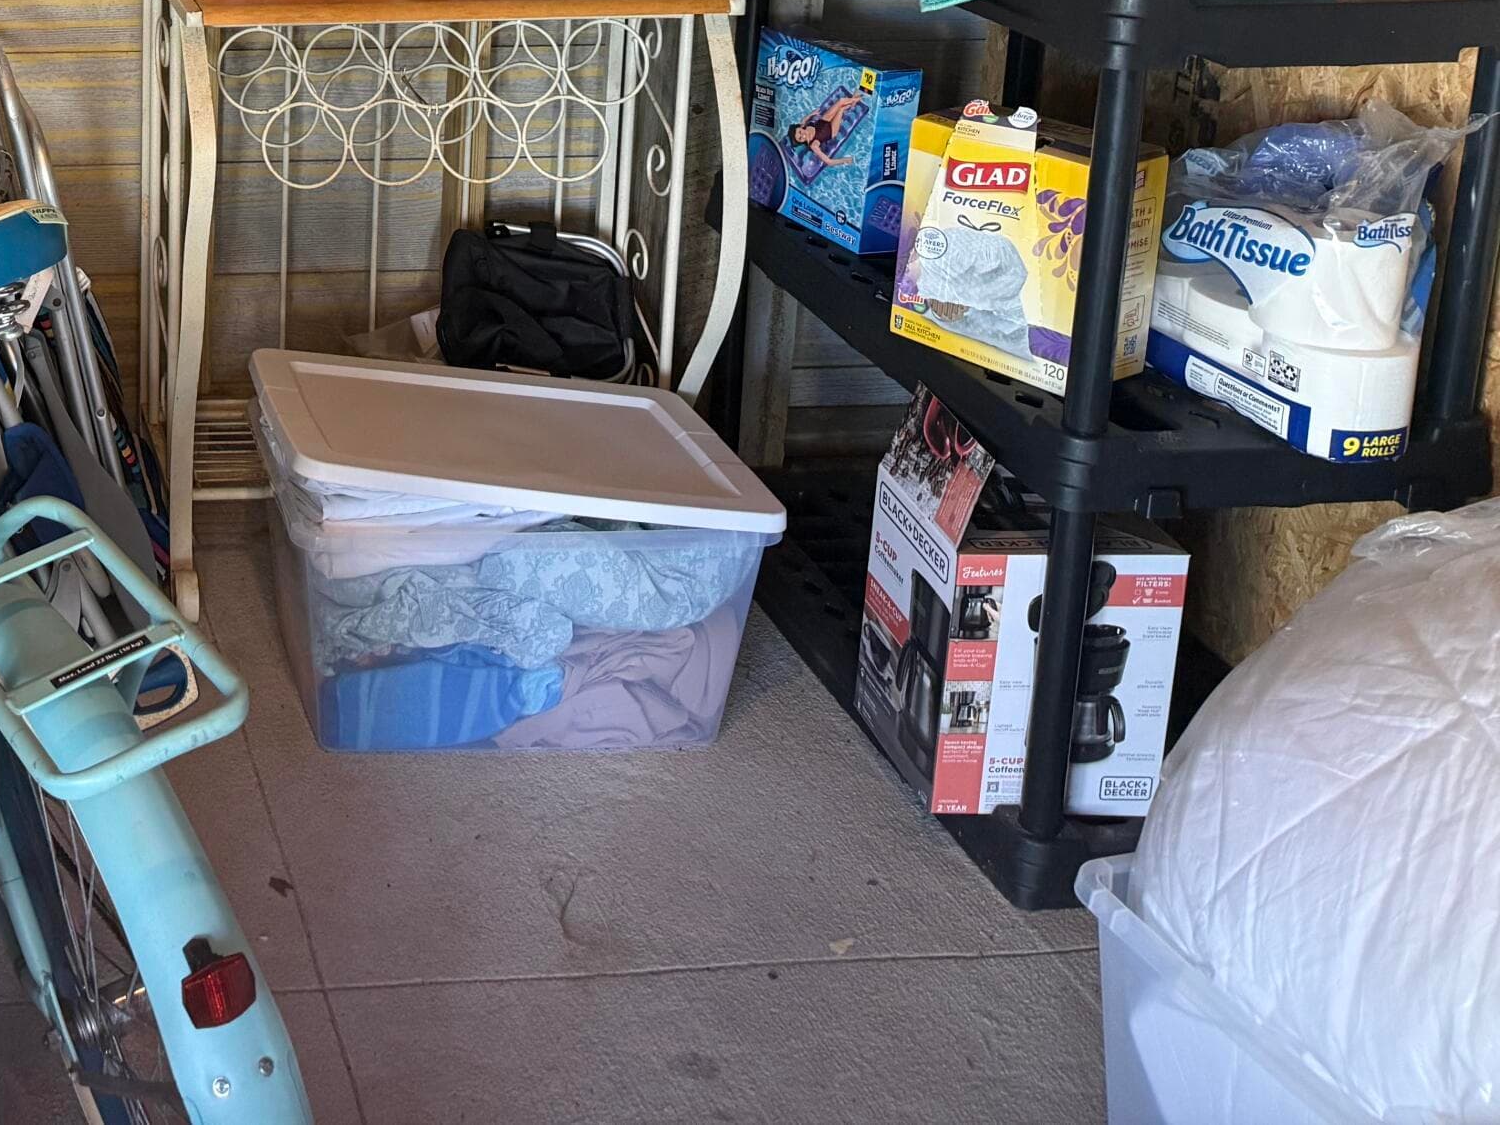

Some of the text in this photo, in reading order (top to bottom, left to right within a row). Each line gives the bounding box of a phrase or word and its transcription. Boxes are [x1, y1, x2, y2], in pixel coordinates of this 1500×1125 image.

[952, 162, 1027, 187] GLAD
[942, 191, 1025, 217] ForceFlex
[916, 327, 941, 341] KITCHEN
[1042, 362, 1065, 381] 120
[1218, 377, 1243, 395] Questions
[1248, 393, 1281, 414] Comments?
[1343, 433, 1403, 456] 9 LARGE
[1361, 445, 1397, 457] ROLLS
[882, 490, 946, 575] BLACK+DECKER
[875, 531, 898, 562] 5-CUP
[962, 566, 1004, 579] Features
[988, 757, 1024, 765] 5-CUP
[1103, 788, 1148, 797] DECKER
[1104, 780, 1148, 789] BLACK+
[937, 804, 967, 812] 2 YEAR
